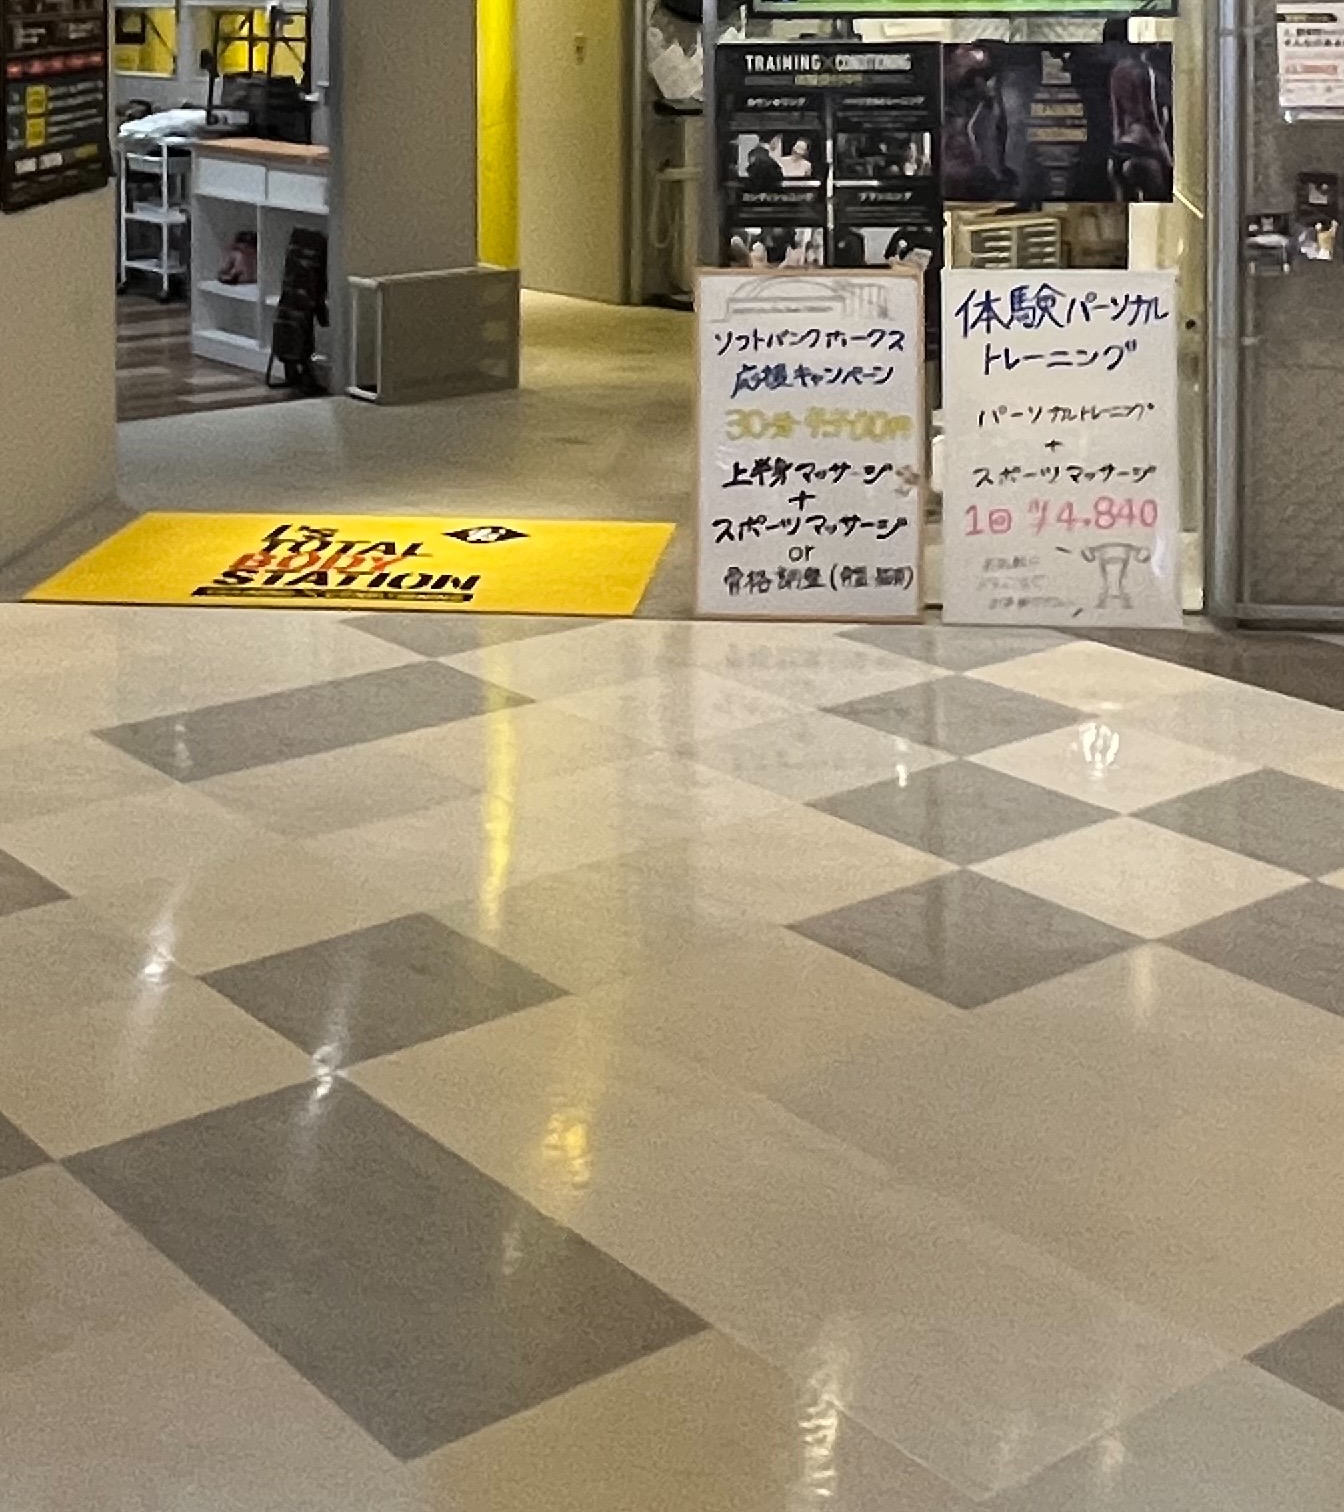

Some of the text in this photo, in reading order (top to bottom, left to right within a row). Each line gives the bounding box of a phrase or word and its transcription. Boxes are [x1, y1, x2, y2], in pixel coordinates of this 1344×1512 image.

[744, 54, 822, 72] TRAINING
[714, 328, 906, 356] ソフトバンクホークス
[984, 339, 1137, 375] トレーニング
[722, 456, 893, 488] 上半身マッサージ
[972, 462, 1157, 488] スポーツマッサージ
[712, 514, 908, 543] スポーツマッサージ
[965, 503, 1012, 536] 1回
[258, 540, 432, 556] TOTAL
[788, 545, 815, 562] or
[229, 552, 407, 573] BODY
[212, 570, 481, 590] STATION
